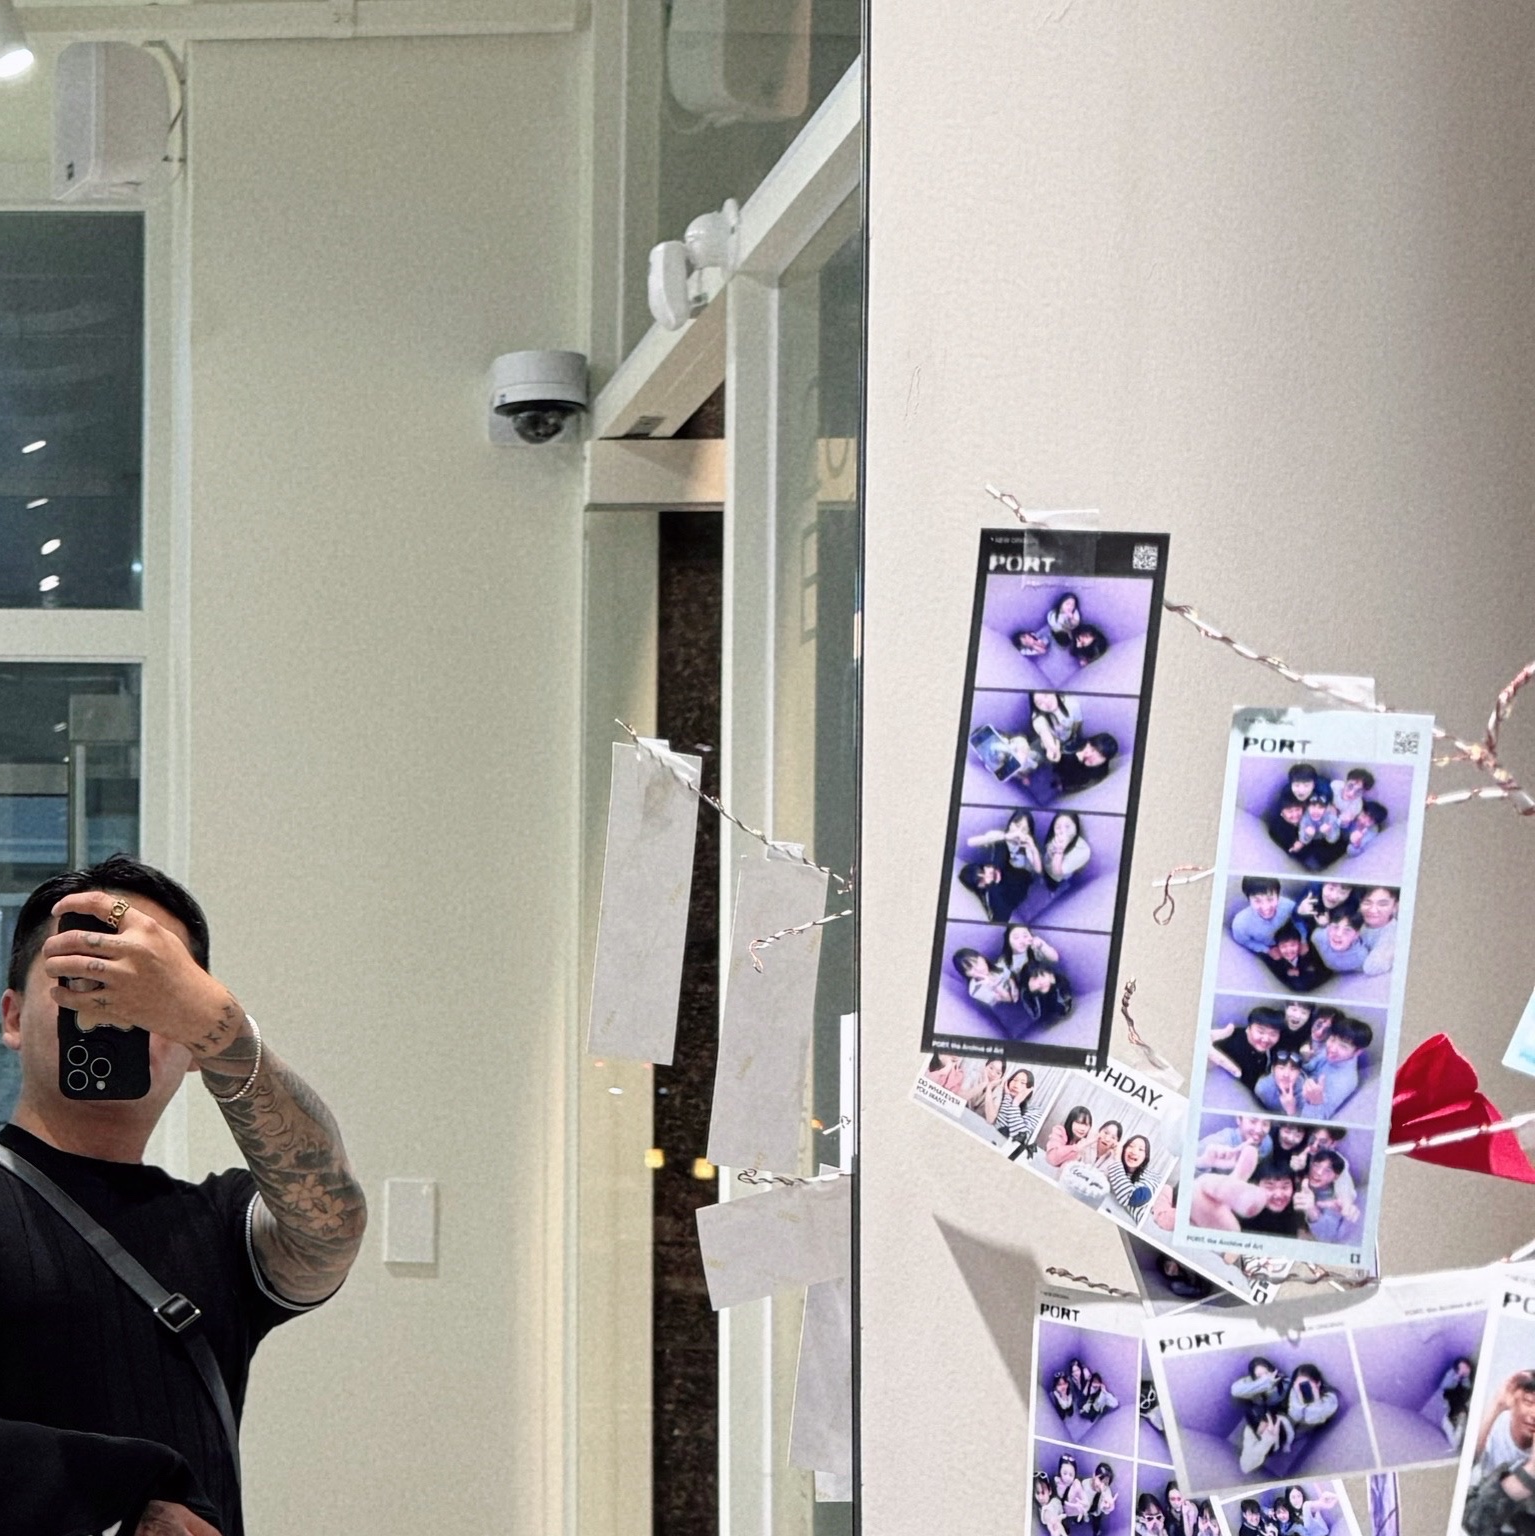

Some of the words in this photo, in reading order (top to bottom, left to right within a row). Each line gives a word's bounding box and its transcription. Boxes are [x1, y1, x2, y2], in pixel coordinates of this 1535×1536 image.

[988, 553, 1056, 572] PORT
[1243, 737, 1312, 754] PORT
[1040, 1303, 1080, 1322] PORT
[1159, 1331, 1225, 1353] PORT
